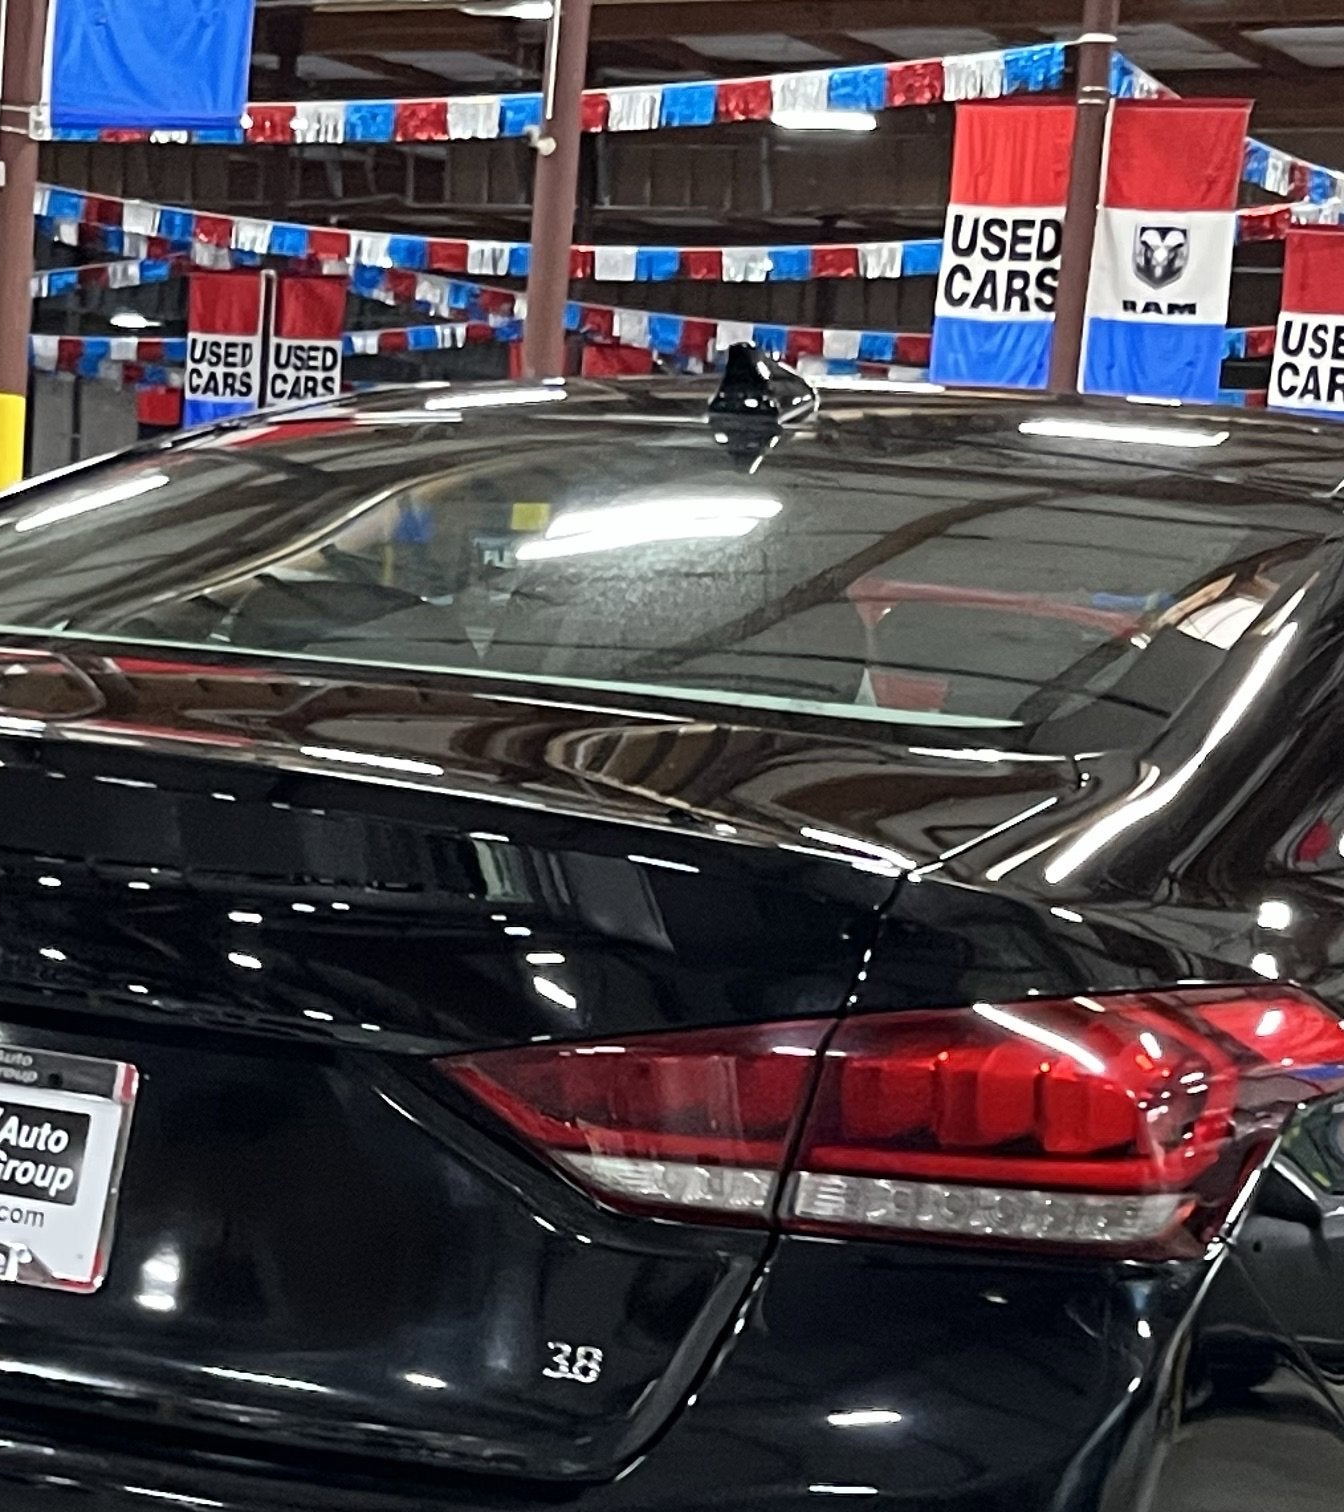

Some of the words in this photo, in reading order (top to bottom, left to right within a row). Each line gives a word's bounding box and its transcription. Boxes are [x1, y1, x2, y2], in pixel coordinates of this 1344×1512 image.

[951, 214, 1063, 262] USED
[944, 264, 1059, 312] CARS
[189, 338, 253, 368] USED
[274, 342, 338, 372] USED
[188, 368, 253, 397] CARS
[271, 373, 336, 401] CARS
